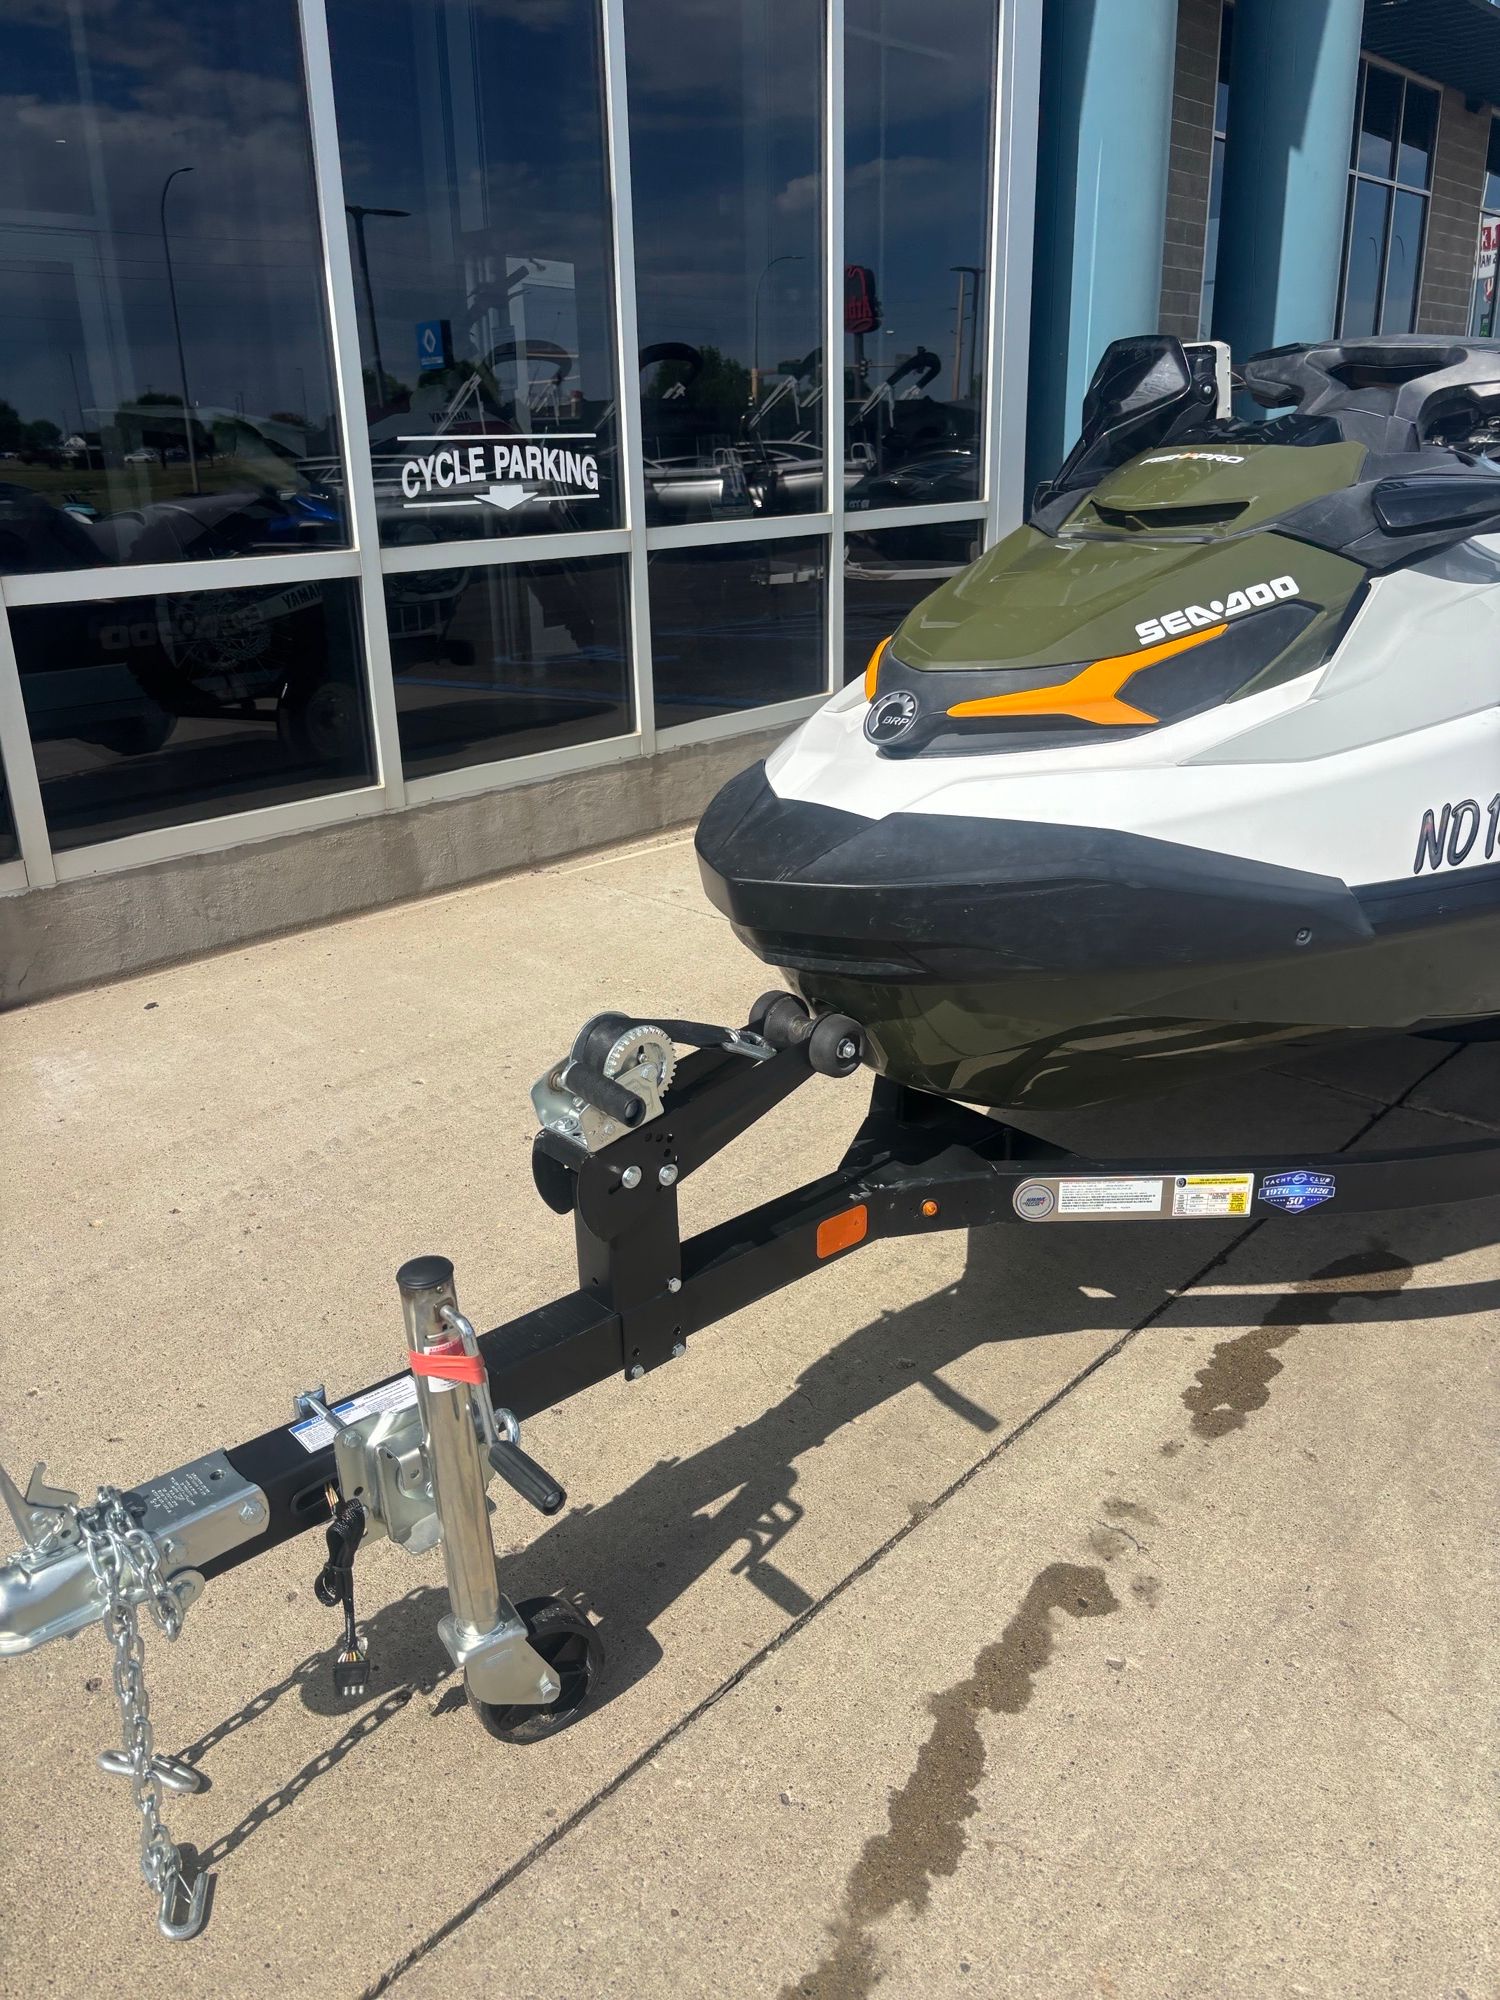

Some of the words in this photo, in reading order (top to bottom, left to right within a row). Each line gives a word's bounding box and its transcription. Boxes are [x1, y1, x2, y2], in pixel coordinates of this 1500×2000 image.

[401, 447, 486, 498] CYCLE
[493, 445, 599, 491] PARKING
[882, 715, 910, 726] BRP
[1413, 799, 1480, 875] ND
[1265, 1177, 1292, 1185] YACHT
